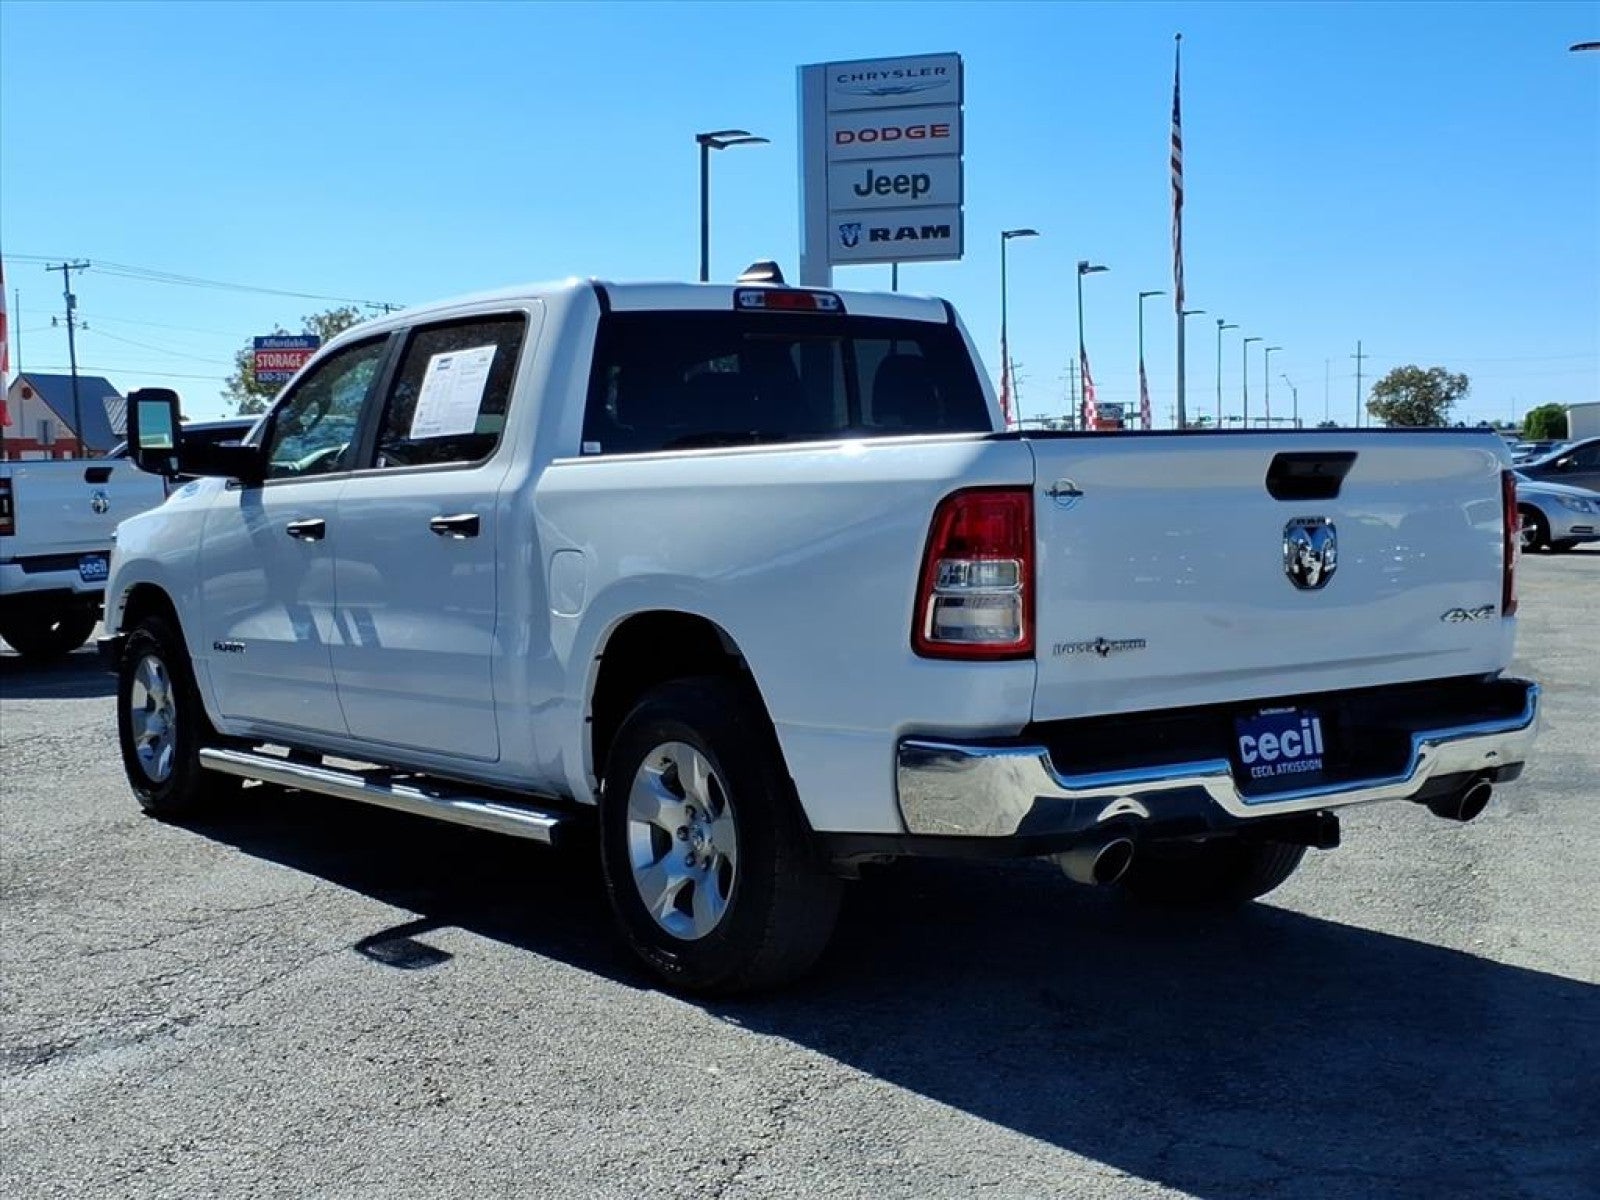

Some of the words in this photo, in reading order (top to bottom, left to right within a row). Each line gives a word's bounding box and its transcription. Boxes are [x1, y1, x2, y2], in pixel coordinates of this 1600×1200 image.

[837, 67, 946, 83] CHRYSLER
[835, 123, 950, 145] DODGE
[854, 169, 931, 199] Jeep
[869, 224, 950, 242] RAM
[256, 352, 302, 368] STORAGE
[1239, 718, 1324, 764] cecil
[1251, 764, 1275, 779] CECIL
